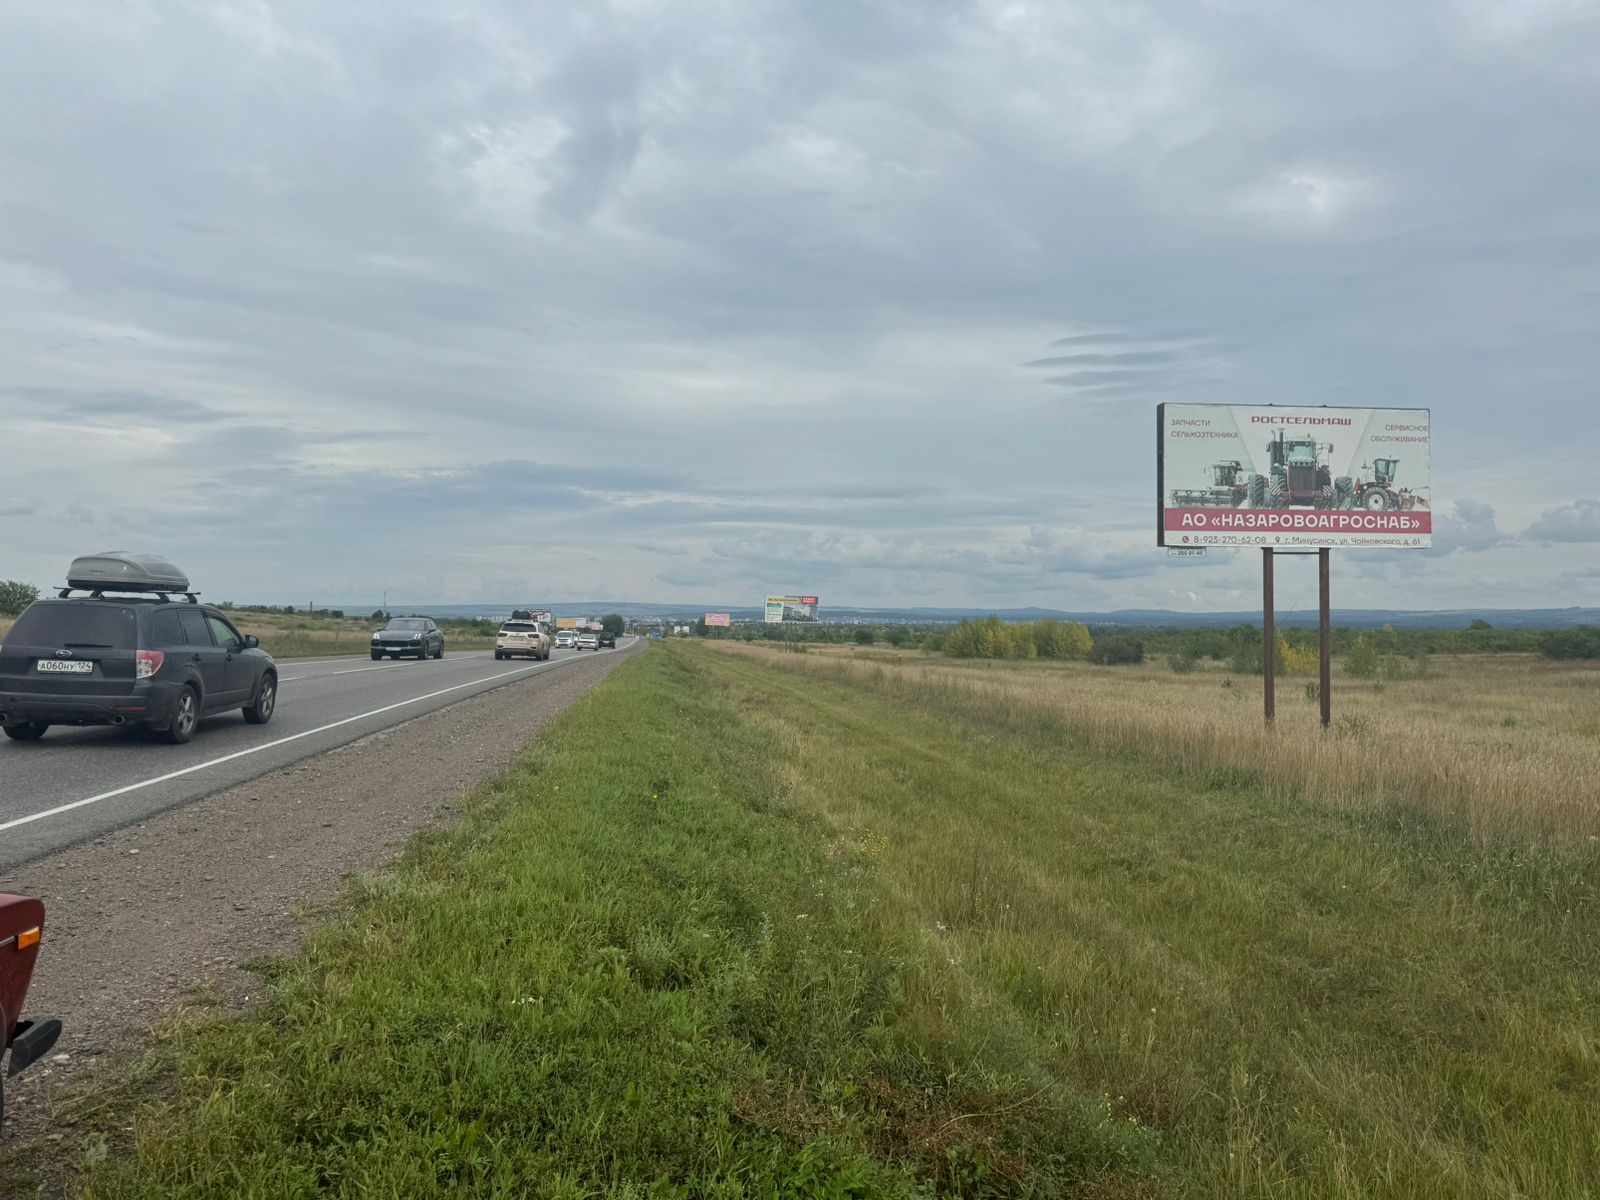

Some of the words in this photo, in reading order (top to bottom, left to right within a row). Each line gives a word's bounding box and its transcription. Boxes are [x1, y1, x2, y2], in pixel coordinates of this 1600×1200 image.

[1170, 419, 1211, 427] ЗАПЧАСТИ
[1252, 416, 1351, 426] РОСТСЕЛЬМАШ
[1182, 513, 1207, 526] АО
[1211, 514, 1420, 529] «НАЗАРОВОАГРОСНАБ»
[1193, 535, 1267, 544] 8-923-270-62-08
[1291, 536, 1338, 546] Минусинск,
[1412, 538, 1421, 546] 61
